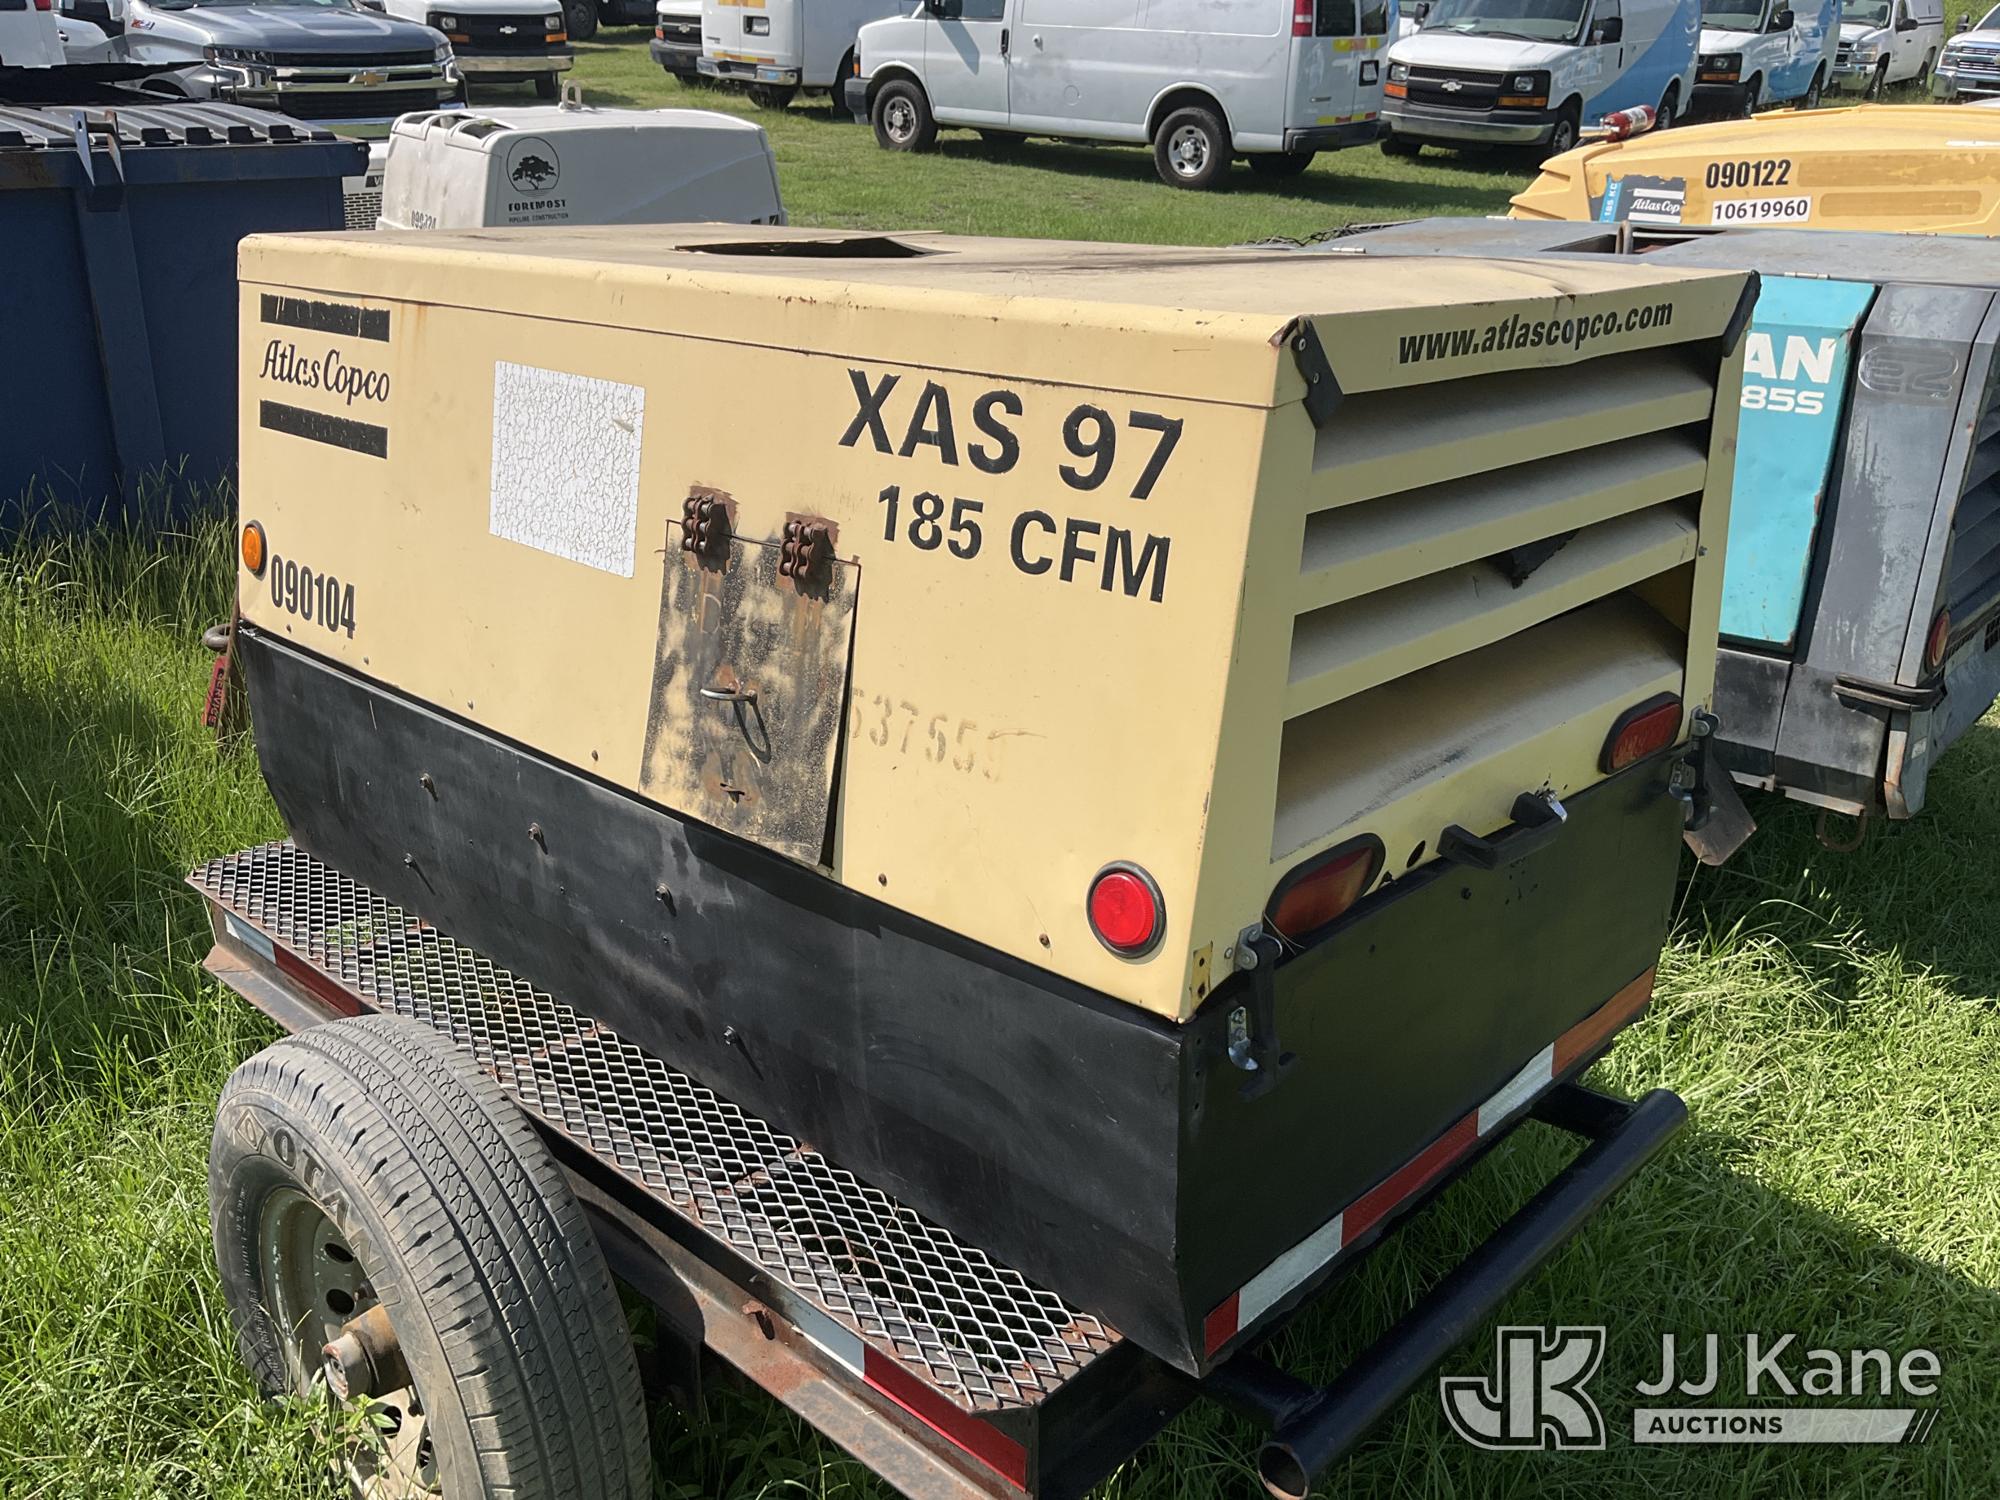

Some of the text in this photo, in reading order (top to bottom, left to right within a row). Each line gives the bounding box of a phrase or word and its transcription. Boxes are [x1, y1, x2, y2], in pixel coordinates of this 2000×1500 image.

[1706, 159, 1792, 189] 090122
[508, 199, 567, 212] FOREMOST
[1630, 199, 1680, 215] Atlas Cop
[1715, 200, 1808, 220] 10619960
[1400, 303, 1673, 364] www.atlascopco.com
[260, 340, 390, 406] Atlas Copco
[838, 368, 1184, 500] XAS 97
[878, 485, 1171, 603] 185 CFM
[271, 554, 356, 640] 090104
